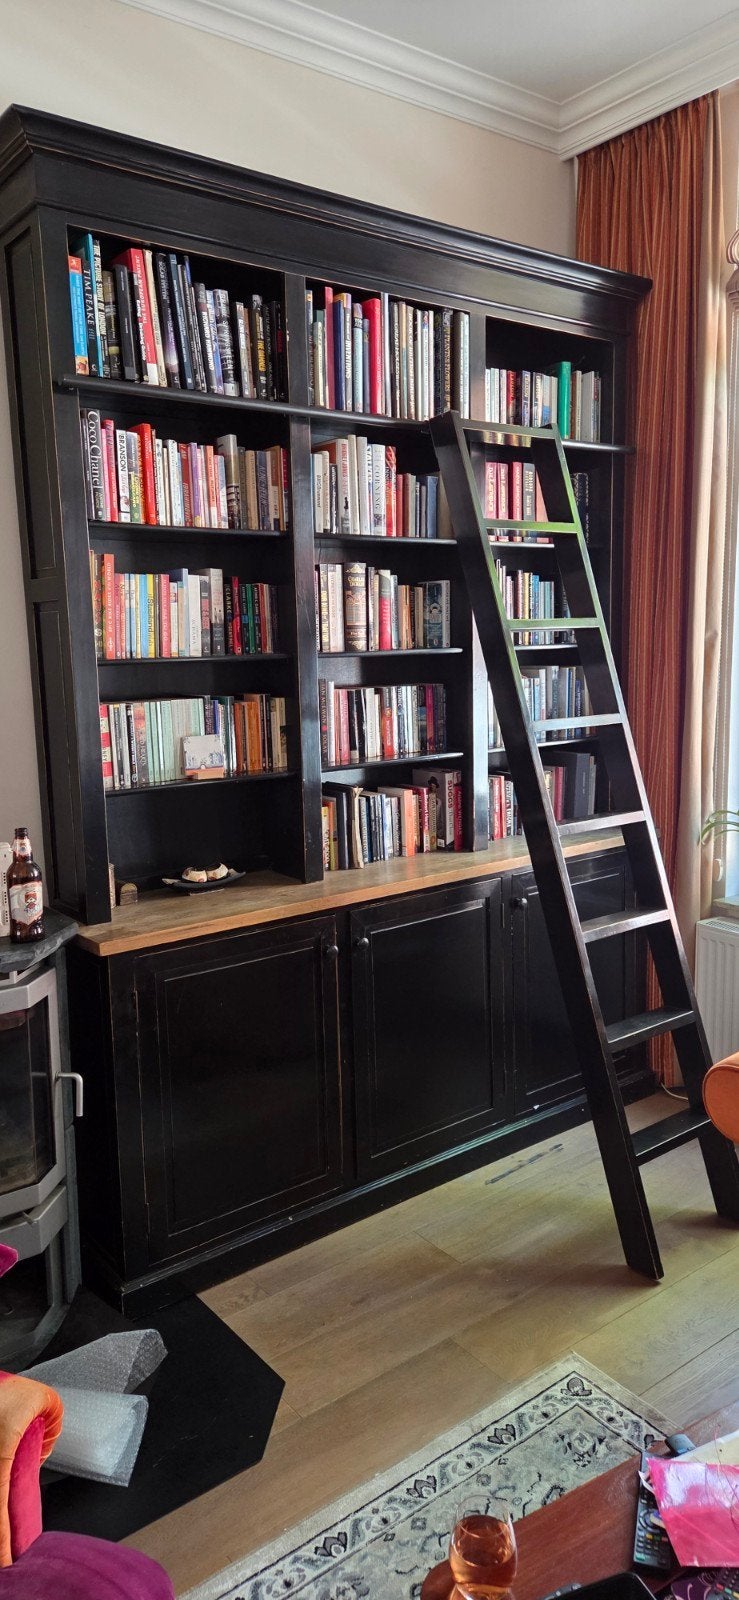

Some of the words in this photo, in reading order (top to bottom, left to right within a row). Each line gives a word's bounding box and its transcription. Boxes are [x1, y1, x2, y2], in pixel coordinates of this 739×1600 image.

[86, 293, 95, 325] PEAKE
[202, 311, 210, 338] RICHARD
[206, 340, 214, 370] HAMMOND
[222, 320, 234, 369] SPRINGSTEEN
[88, 411, 98, 443] Coco
[90, 445, 103, 489] Chanel
